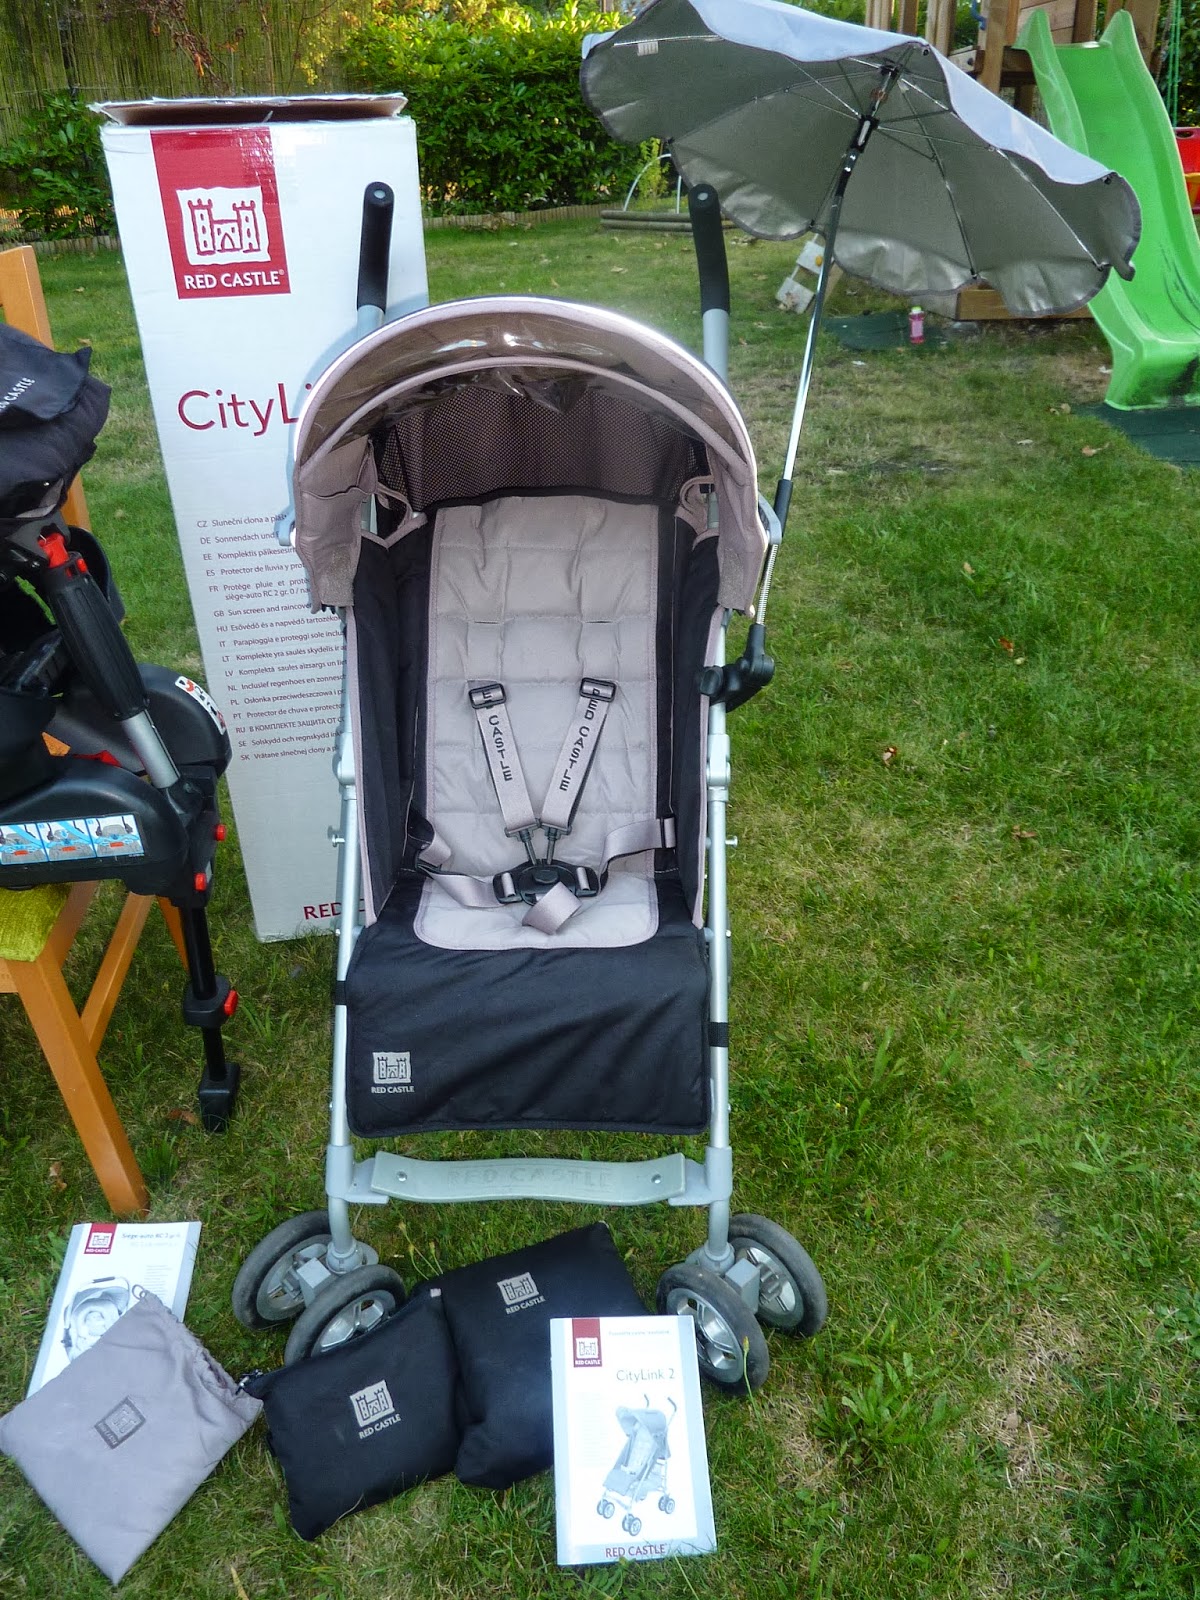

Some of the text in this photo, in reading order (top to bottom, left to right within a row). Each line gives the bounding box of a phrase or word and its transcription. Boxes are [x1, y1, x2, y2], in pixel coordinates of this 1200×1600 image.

[184, 274, 217, 290] RED
[4, 377, 35, 401] CASTLE
[177, 382, 313, 437] CityL
[196, 520, 208, 528] CZ
[243, 516, 264, 524] clona
[200, 537, 211, 545] DE
[214, 533, 260, 543] Sonnendach
[260, 532, 275, 540] und
[203, 553, 212, 561] EE
[217, 550, 257, 560] Komplektis
[220, 566, 253, 576] Protector
[254, 565, 263, 573] de
[264, 563, 284, 571] lluvia
[223, 583, 251, 592] Protège
[255, 581, 273, 590] pluie
[225, 592, 262, 601] siège-auto
[228, 607, 242, 616] Sun
[242, 606, 265, 615] screen
[266, 604, 280, 612] and
[306, 615, 341, 624] tartozéko
[233, 637, 274, 646] Parapioggia
[280, 632, 310, 643] proteggi
[236, 651, 273, 661] Komplekte
[273, 651, 285, 659] yra
[299, 661, 326, 669] aizsargs
[241, 681, 270, 690] Inclusief
[270, 678, 306, 688] regenhoes
[271, 690, 333, 702] przeciwdeszczowa
[246, 710, 277, 718] Protector
[287, 706, 308, 715] chuva
[251, 737, 281, 746] Solskydd
[281, 735, 295, 743] och
[295, 731, 330, 742] regnskydd
[307, 746, 326, 754] clony
[488, 715, 513, 781] CASTLE
[559, 726, 590, 792] CASTLE
[371, 1085, 414, 1094] RED CASTLE
[505, 1296, 546, 1314] RED CASTLE
[616, 1368, 675, 1383] CityLink 2
[359, 1414, 402, 1439] RED CASTLE
[605, 1546, 626, 1558] RED
